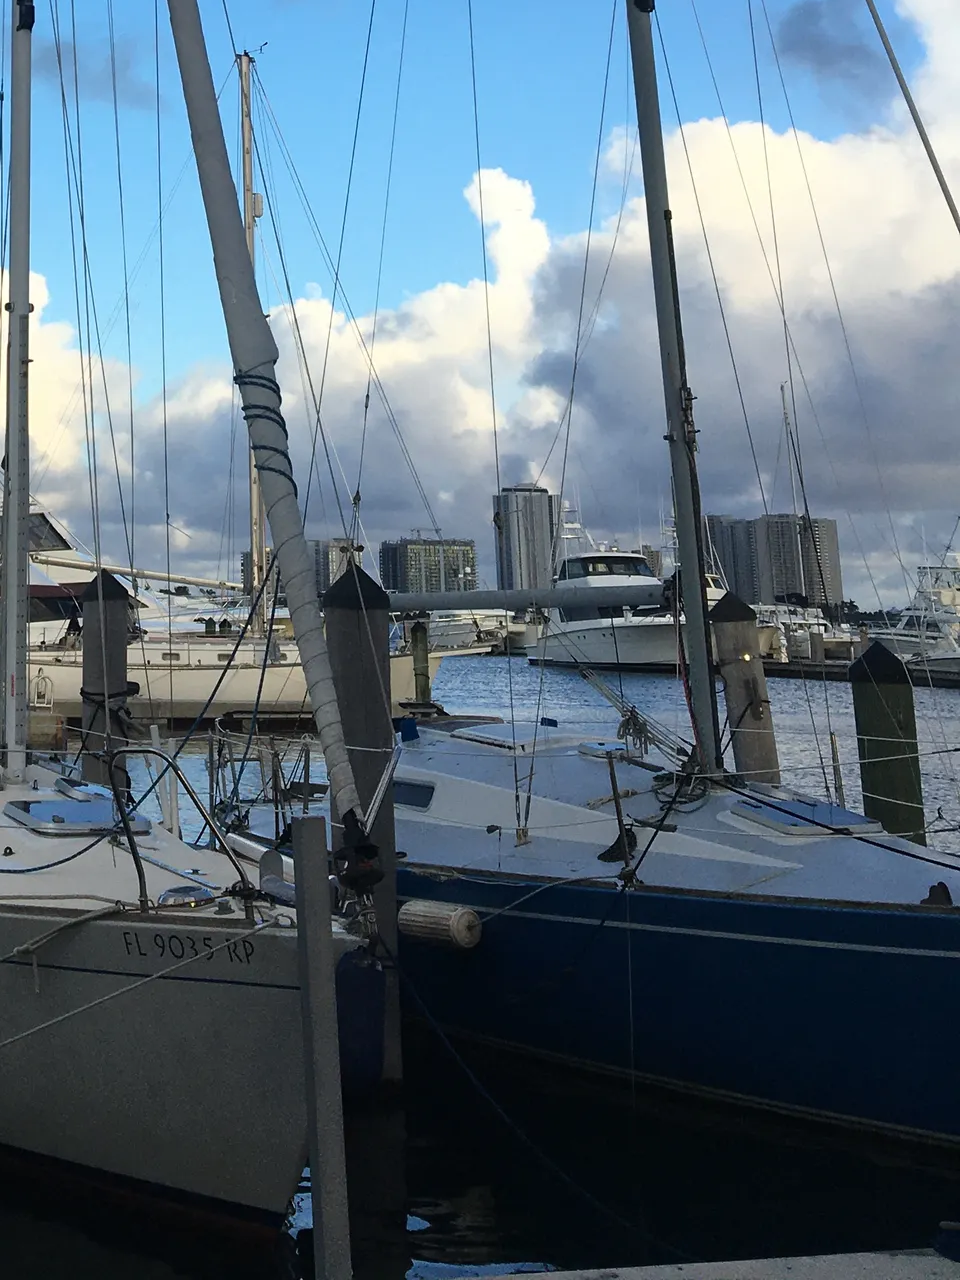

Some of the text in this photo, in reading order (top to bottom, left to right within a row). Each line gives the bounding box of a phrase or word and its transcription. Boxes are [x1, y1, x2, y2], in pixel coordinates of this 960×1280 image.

[123, 931, 255, 964] FL 9035 RP
